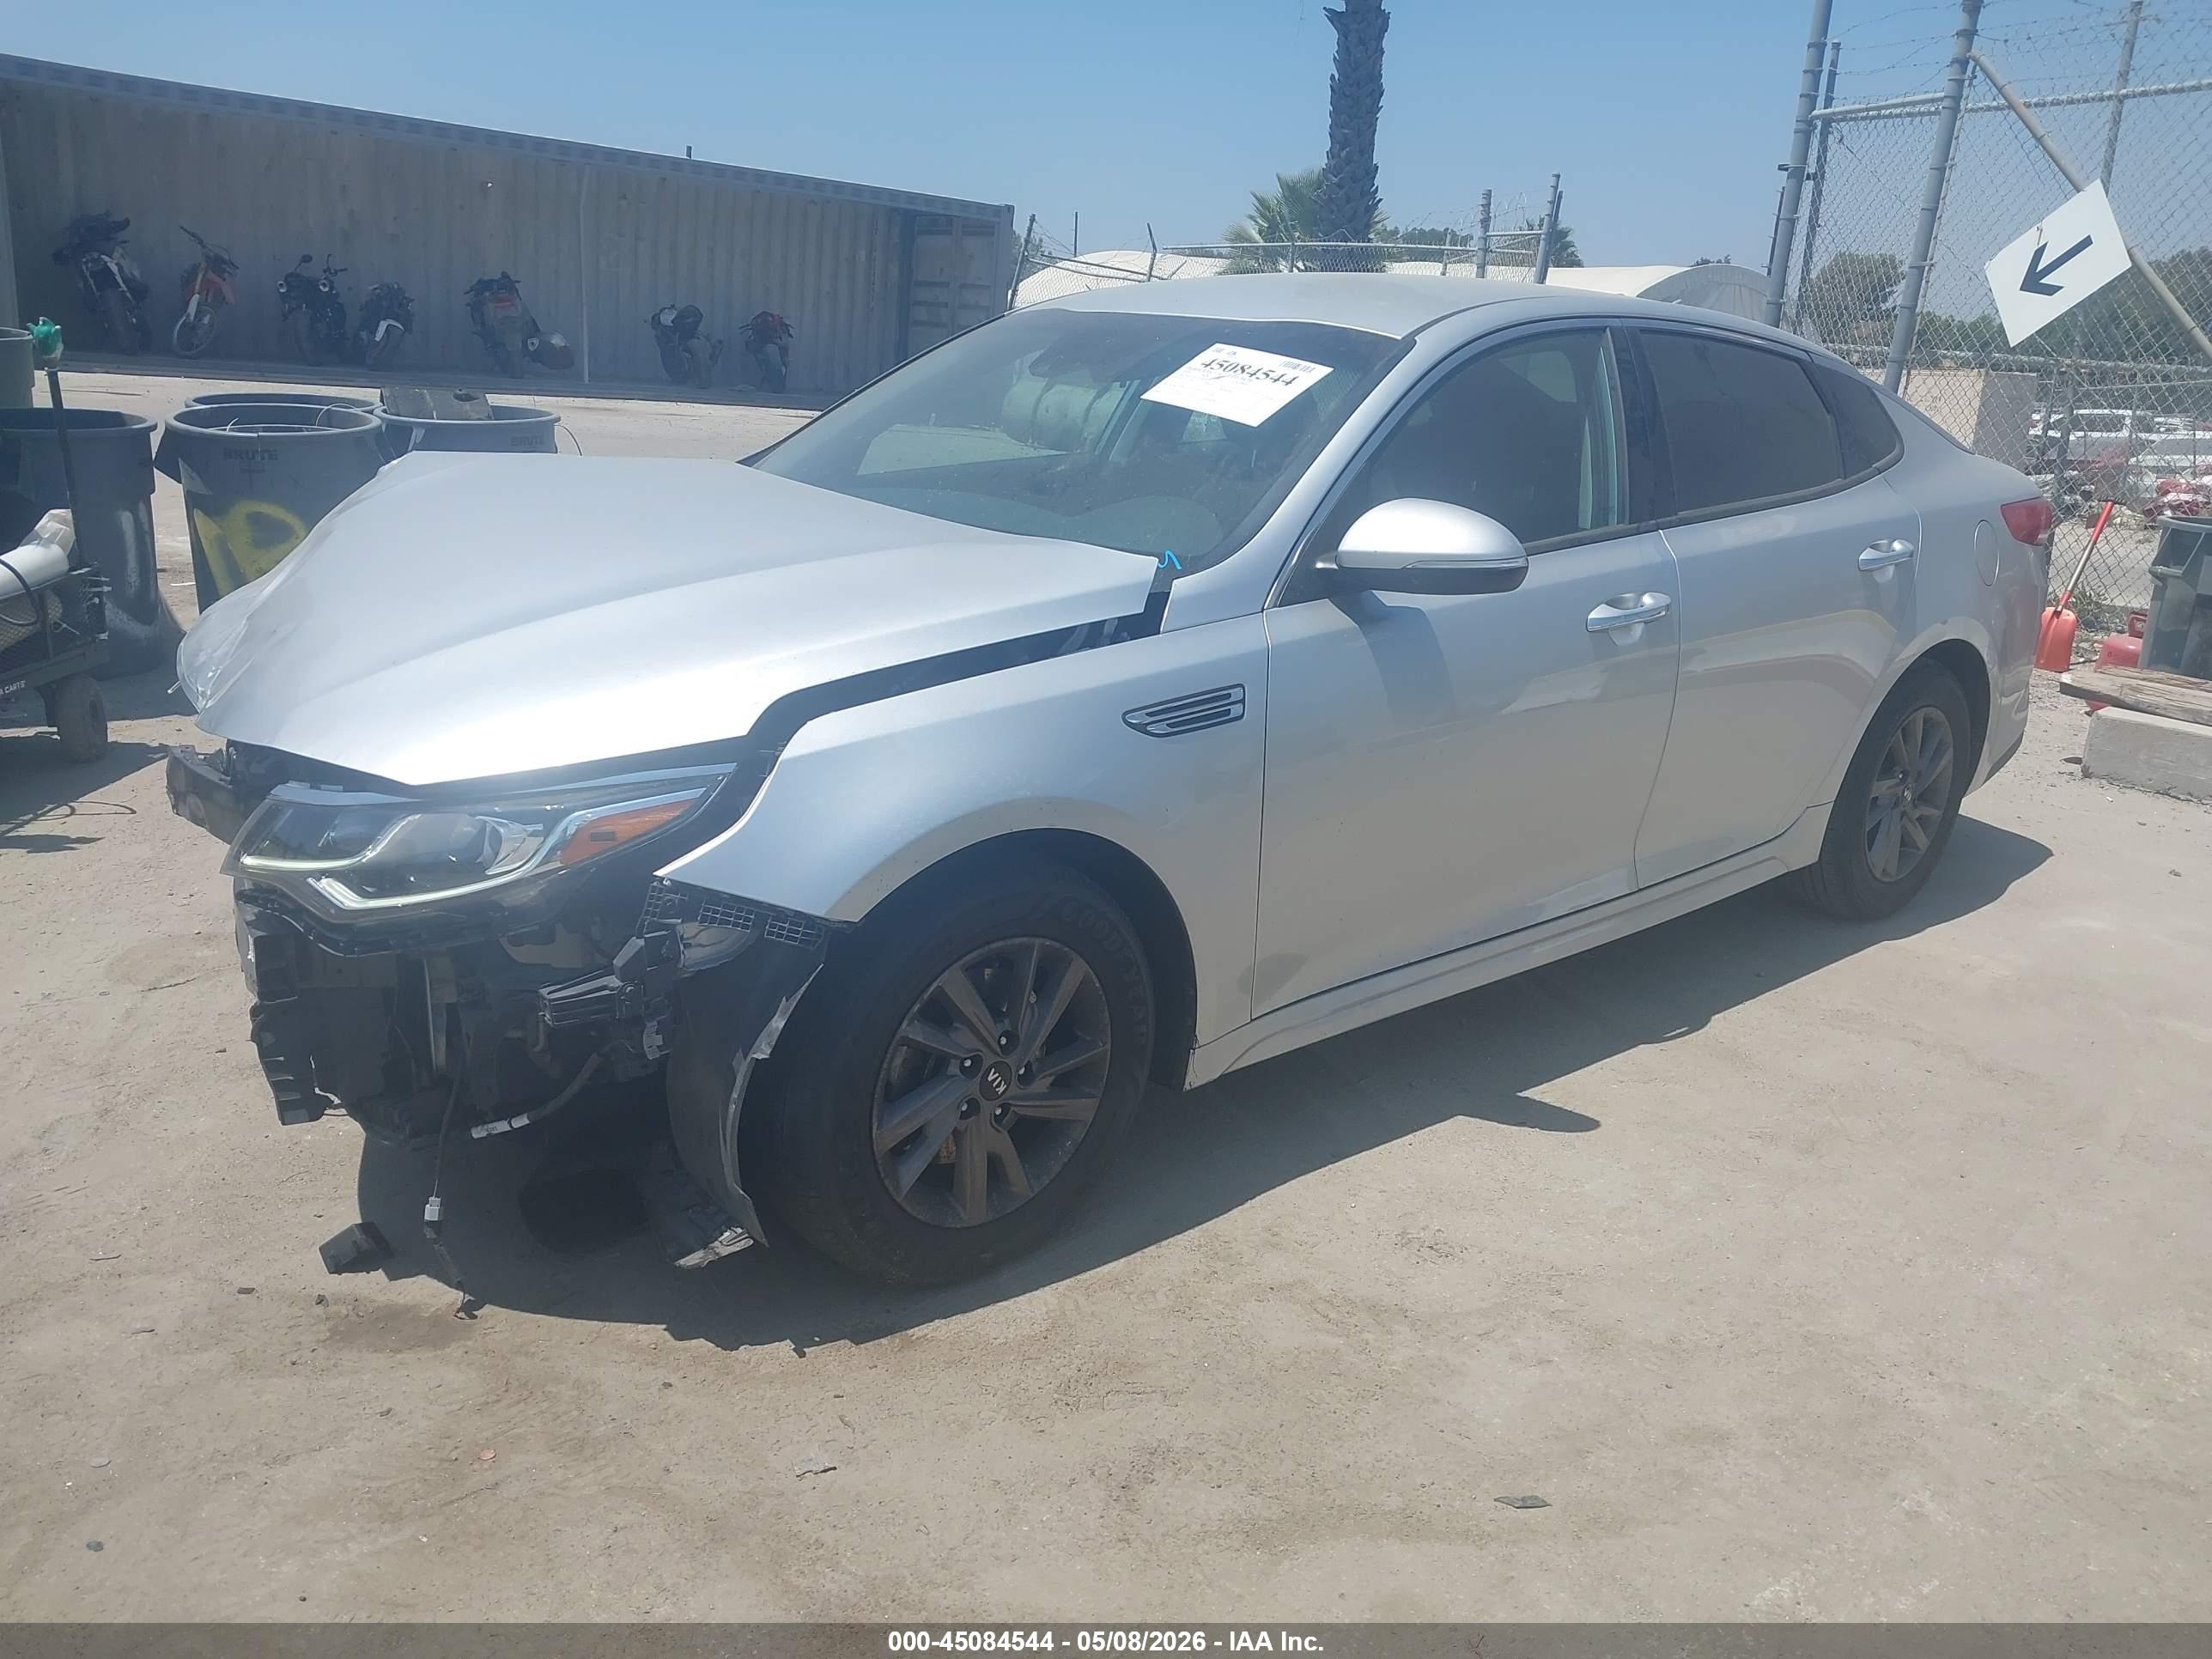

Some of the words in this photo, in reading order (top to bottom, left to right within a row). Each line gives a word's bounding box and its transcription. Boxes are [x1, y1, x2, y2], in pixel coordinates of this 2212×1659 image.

[1200, 358, 1300, 386] 45084544
[223, 448, 279, 461] BRUTE
[988, 1067, 1007, 1096] KIA
